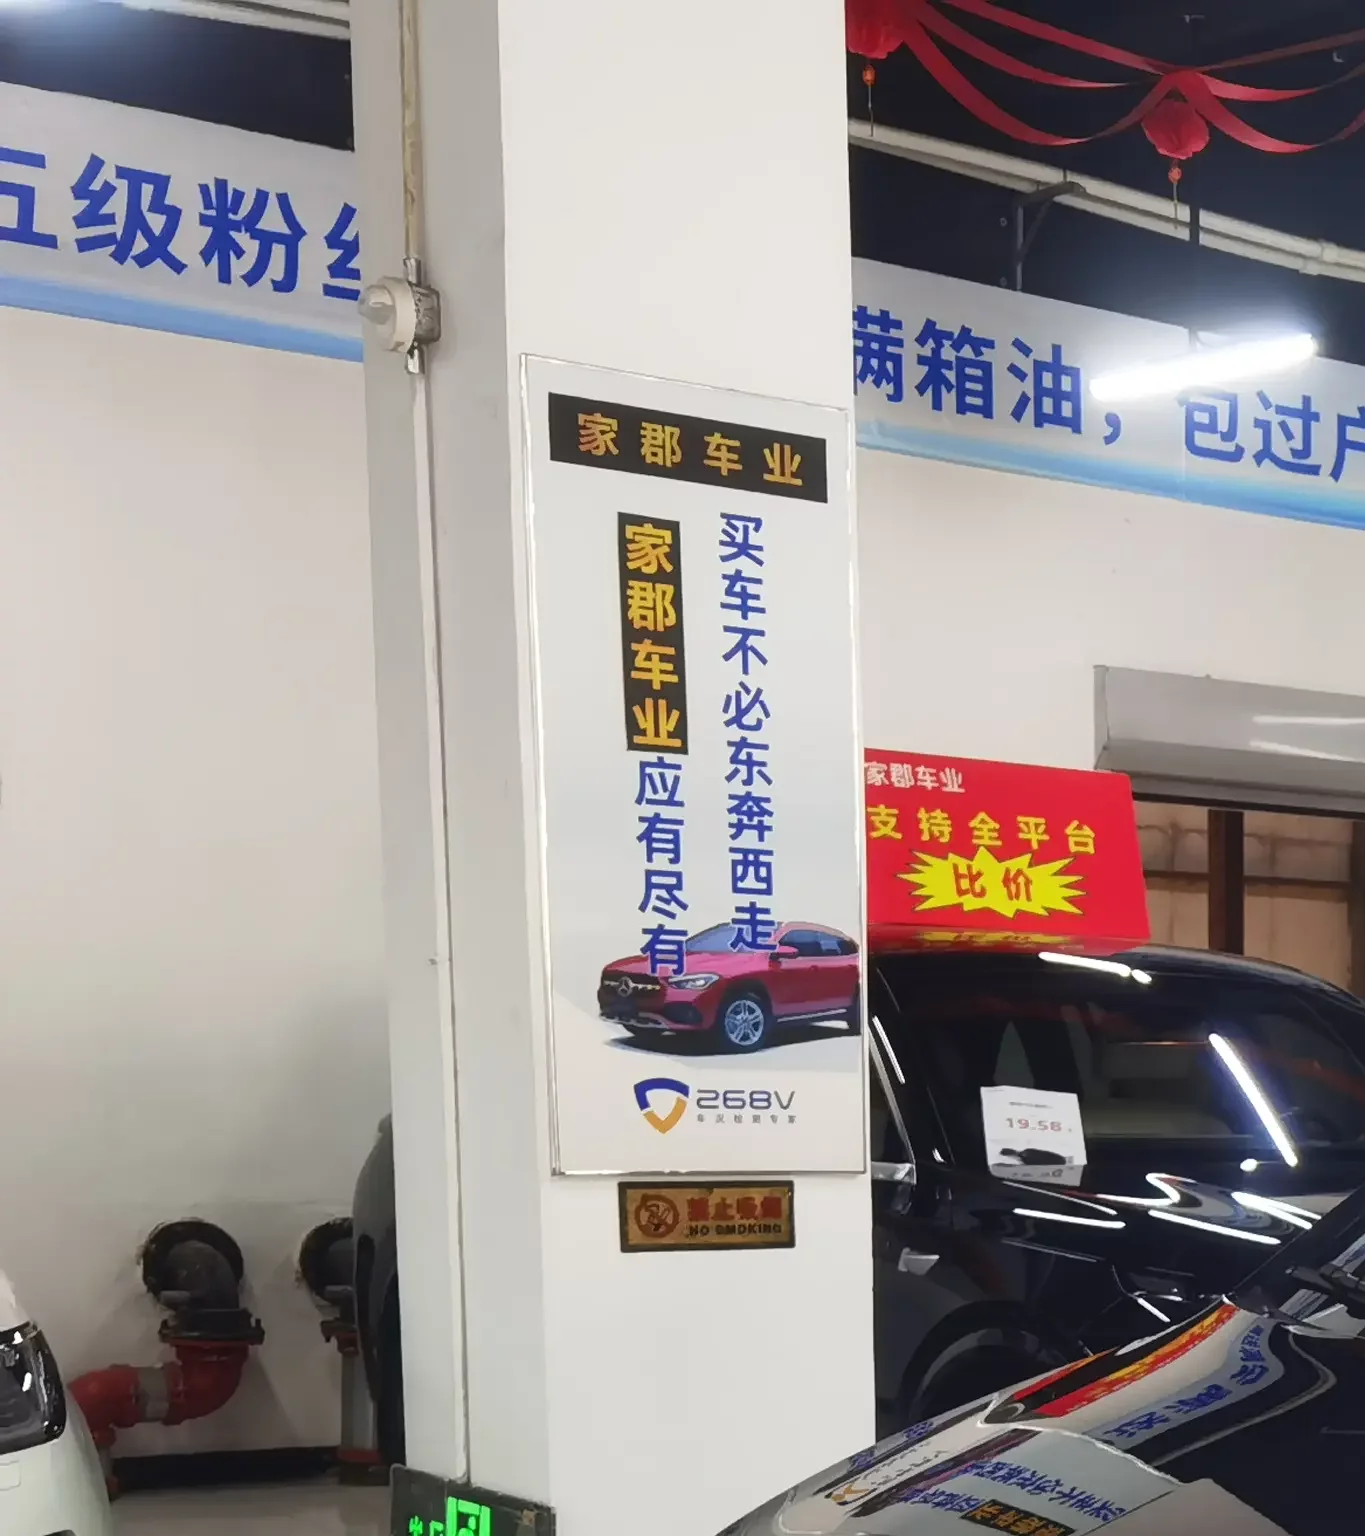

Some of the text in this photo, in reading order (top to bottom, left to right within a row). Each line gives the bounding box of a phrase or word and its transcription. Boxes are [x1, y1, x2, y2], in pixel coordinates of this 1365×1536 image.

[577, 413, 803, 486] 家郡车业
[718, 512, 777, 953] 买车不必东奔西走
[864, 761, 965, 793] 家郡车业
[866, 804, 1096, 855] 支持全平台
[952, 862, 1033, 902] 比价
[696, 1088, 796, 1111] 268V
